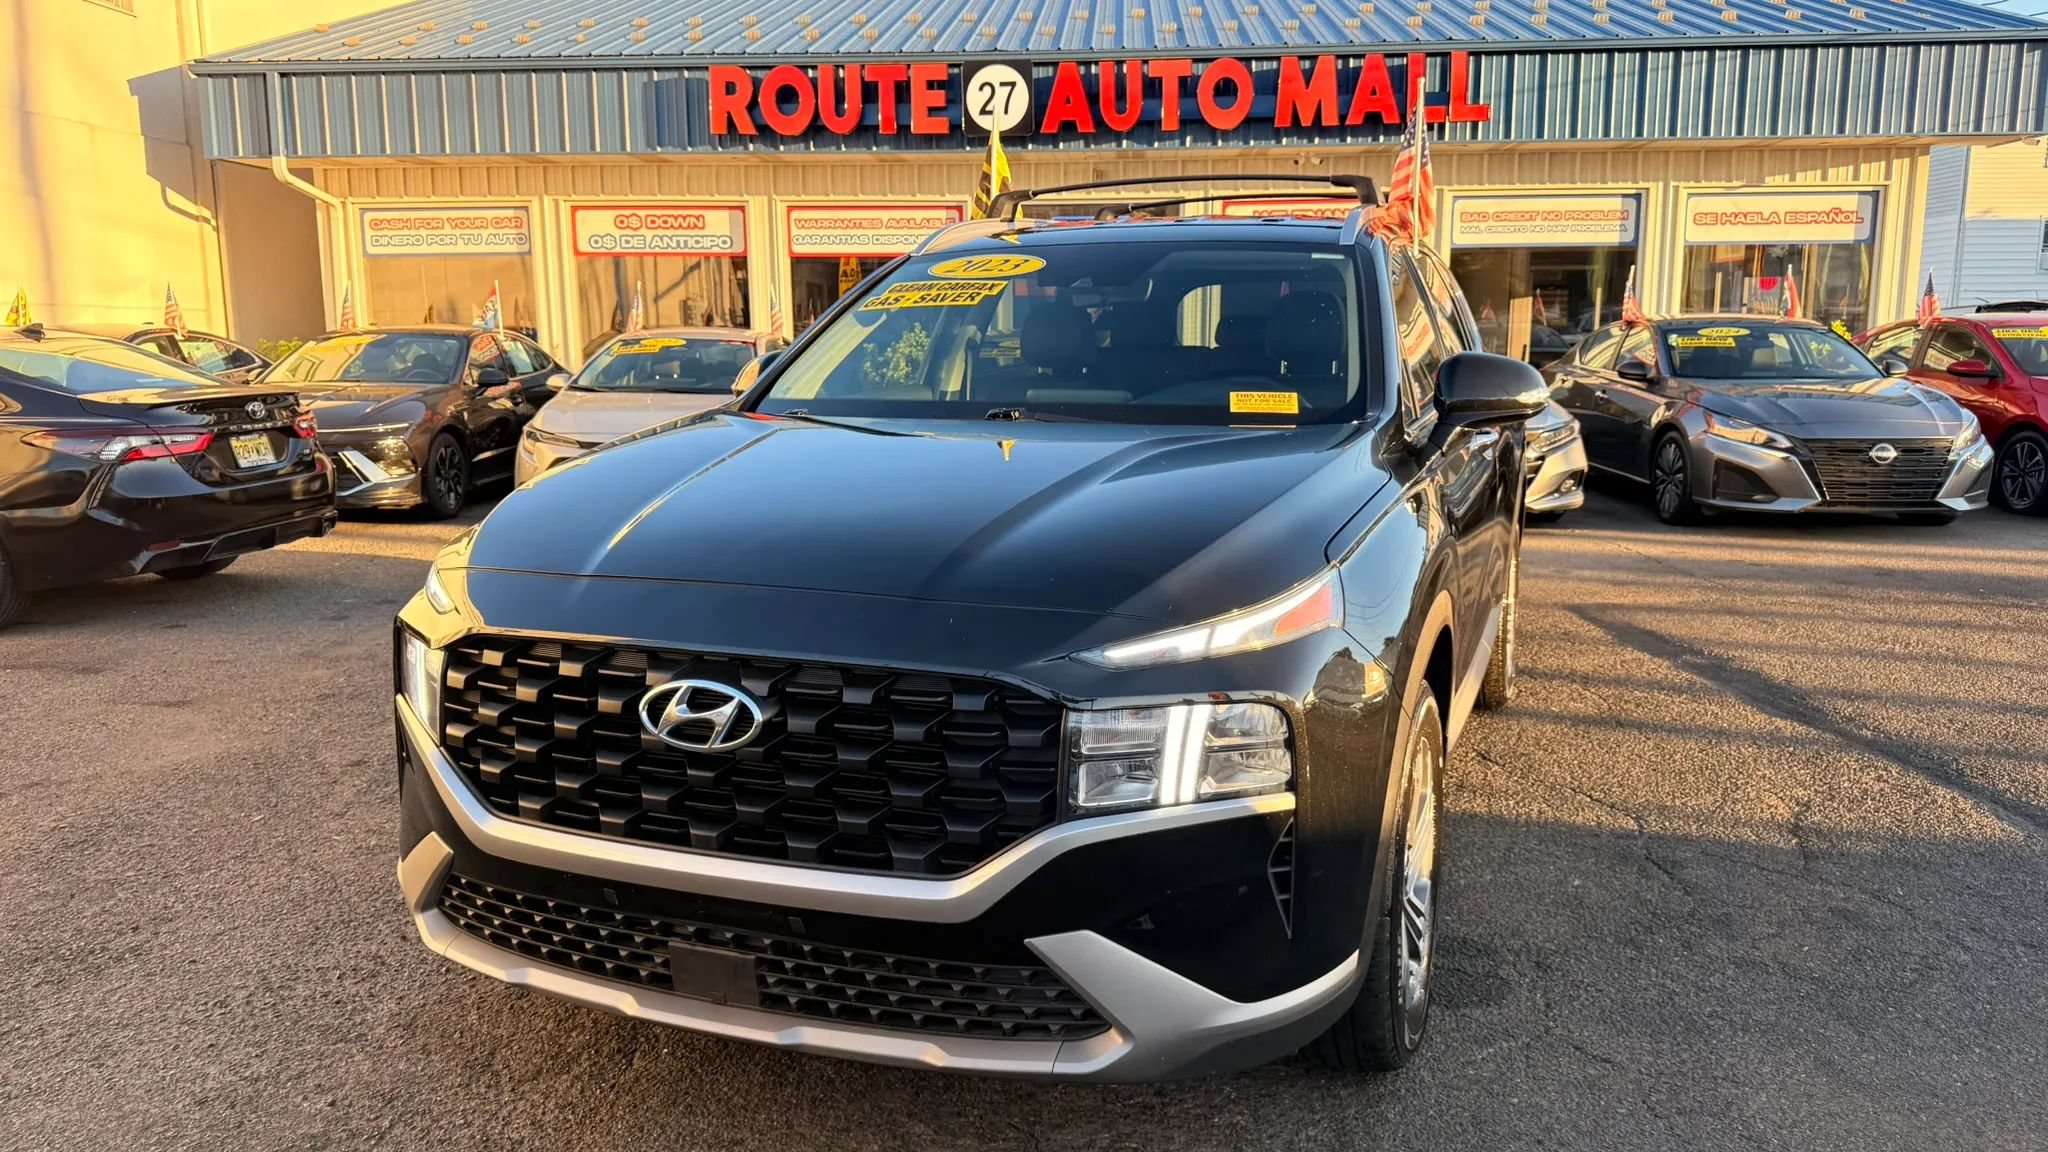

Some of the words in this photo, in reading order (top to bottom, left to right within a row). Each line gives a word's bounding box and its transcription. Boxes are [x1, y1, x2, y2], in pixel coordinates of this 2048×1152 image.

[709, 63, 951, 136] ROUTE
[977, 80, 1017, 116] 27
[1040, 57, 1254, 134] AUTO
[1274, 51, 1491, 128] MALL
[370, 218, 412, 230] CASH
[414, 217, 444, 230] FOR
[447, 217, 489, 230] YOUR
[490, 216, 523, 230] CAR
[645, 214, 705, 230] DOWN
[1460, 212, 1489, 223] BAD
[1493, 211, 1539, 222] CREDIT
[1541, 211, 1562, 221] NO
[1564, 210, 1629, 221] PROBLEM
[1694, 212, 1718, 225] SE
[1720, 211, 1781, 225] HABLA
[1784, 207, 1864, 224] ESPAÑOL
[794, 218, 883, 230] WARRANTIES
[1460, 225, 1483, 234] MAL
[1485, 225, 1527, 233] CREDITO
[1529, 225, 1545, 233] NO
[1547, 225, 1569, 233] HAY
[1570, 224, 1627, 232] PROBLEMA
[371, 234, 424, 247] DINERO
[427, 234, 458, 246] POR
[460, 234, 482, 245] TU
[485, 233, 527, 246] AUTO
[620, 235, 646, 248] DE
[649, 235, 733, 249] ANTICIPO
[793, 234, 869, 245] GARANTIAS
[943, 258, 1031, 273] 2023
[887, 281, 938, 293] CLEAN
[937, 281, 1001, 292] CARFAX
[915, 291, 982, 305] SAVER
